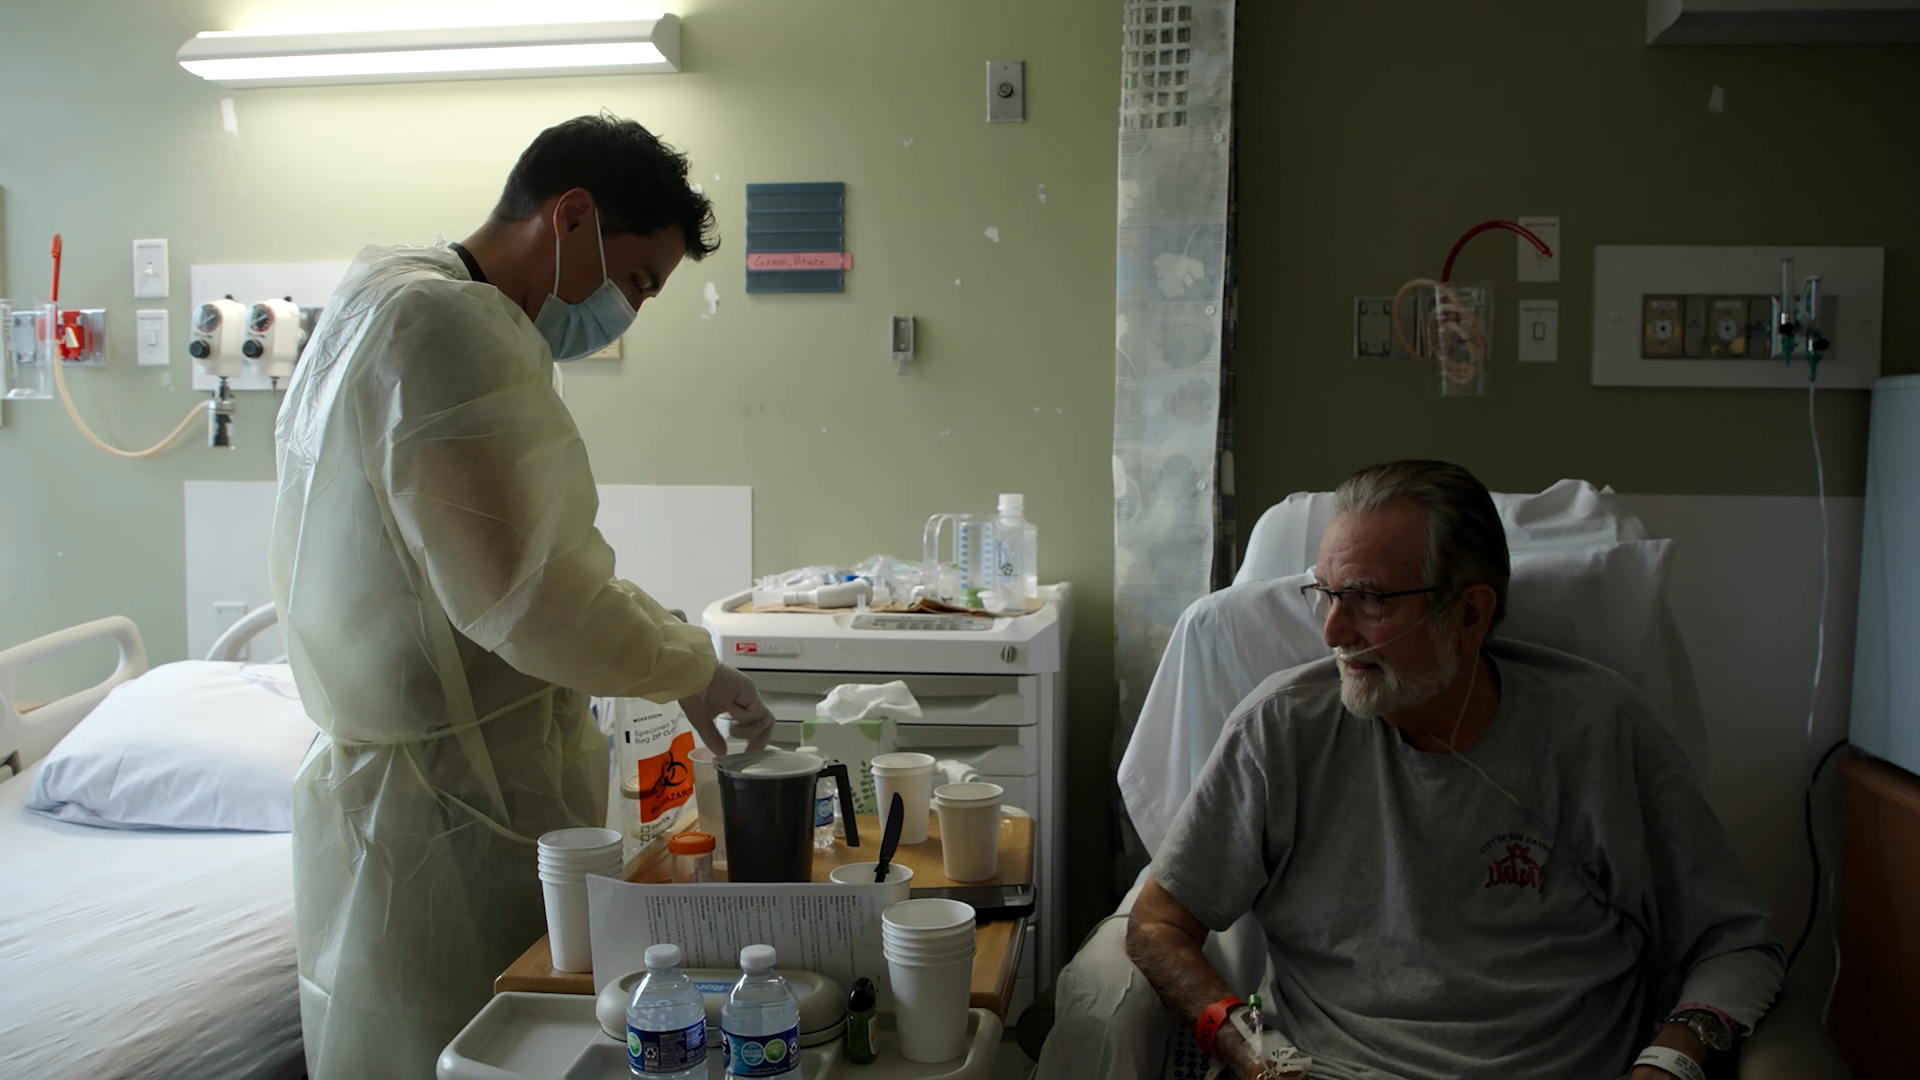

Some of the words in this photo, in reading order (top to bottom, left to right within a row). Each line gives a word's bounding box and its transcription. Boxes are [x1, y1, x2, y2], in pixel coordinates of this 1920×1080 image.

[634, 723, 670, 738] Specimen
[634, 737, 651, 745] Bag
[652, 732, 662, 741] ZIP
[1479, 838, 1497, 854] CITY
